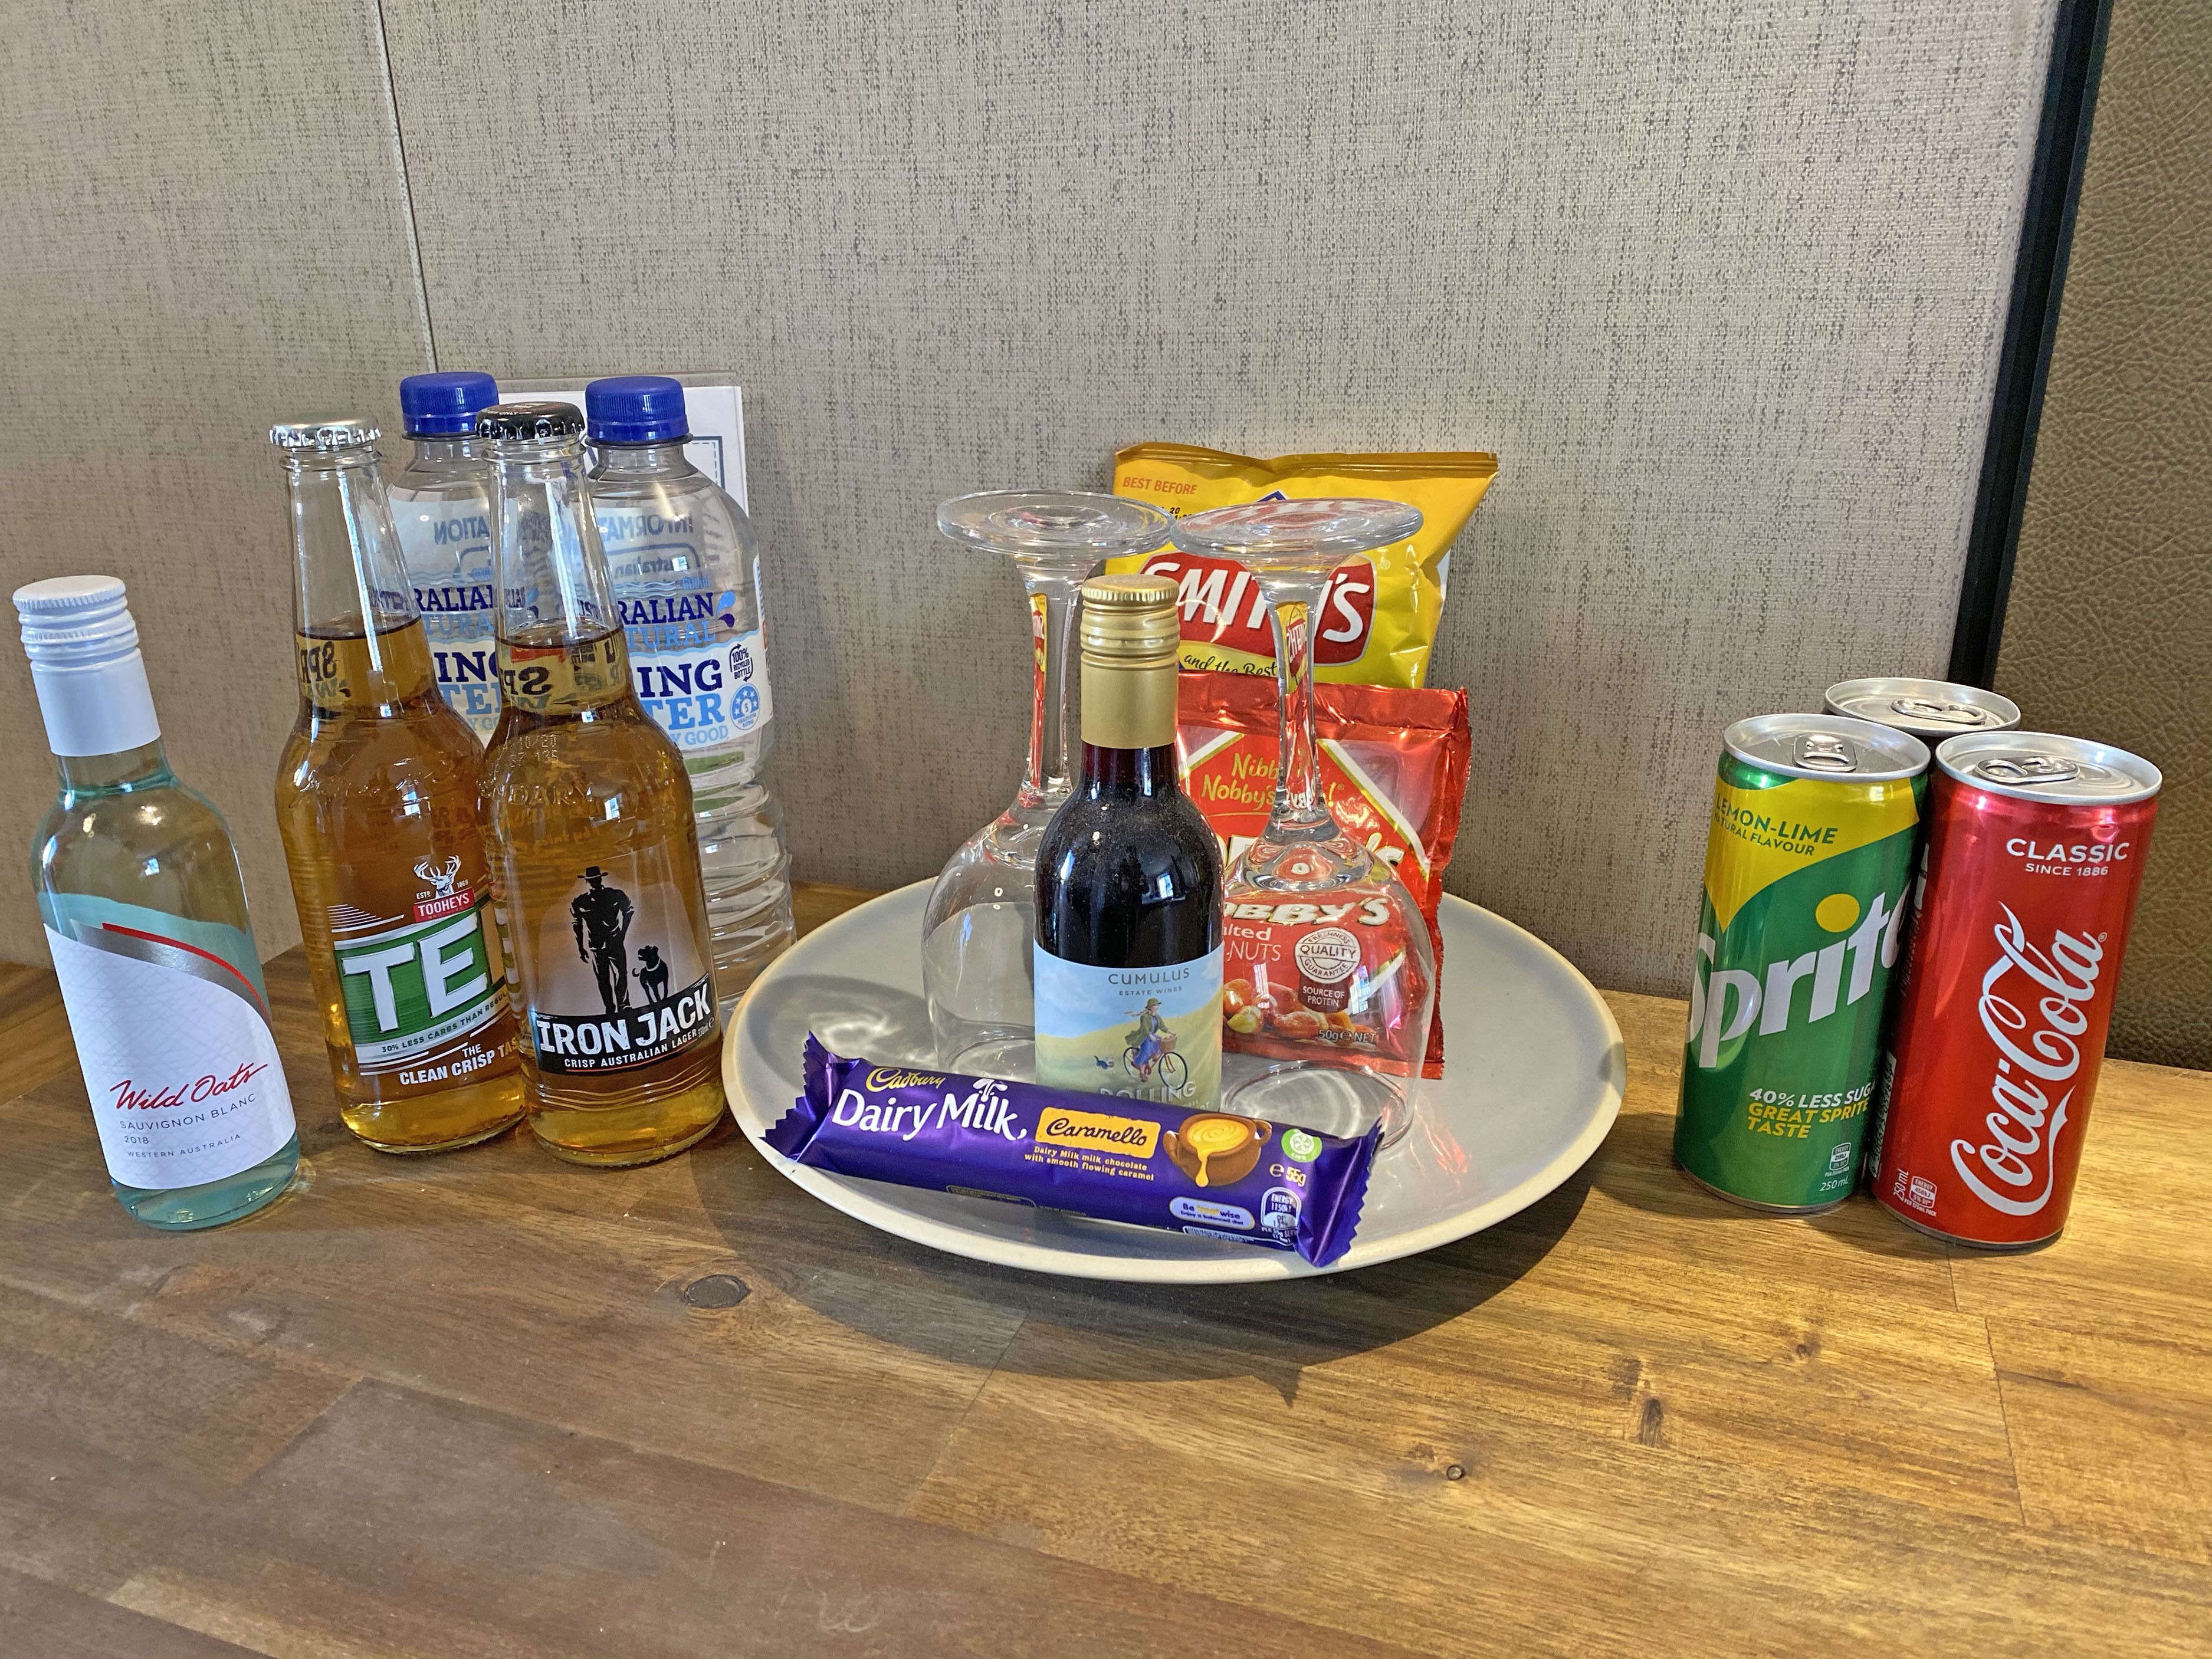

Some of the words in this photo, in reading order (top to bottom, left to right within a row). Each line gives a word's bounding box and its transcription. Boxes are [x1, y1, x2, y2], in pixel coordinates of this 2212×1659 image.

[1123, 477, 1151, 490] BEST
[1154, 480, 1198, 495] BEFORE
[618, 592, 714, 625] RALIAN
[624, 620, 717, 649] TURAL
[732, 648, 749, 663] 100%
[1184, 655, 1216, 670] and
[636, 659, 723, 698] ING
[734, 666, 751, 679] BOTTLE
[641, 693, 725, 730] TER
[685, 725, 728, 745] GOOD
[1232, 753, 1279, 780] Nibb
[1201, 774, 1276, 812] Nobby's
[1717, 794, 1838, 845] LEMON-LIME
[1714, 813, 1748, 840] NATURAL
[1750, 832, 1816, 856] FLAVOUR
[2006, 838, 2130, 863] CLASSIC
[2025, 863, 2072, 876] SINCE
[2077, 866, 2108, 876] 1886
[418, 893, 470, 916] TOOHEYS
[1308, 931, 1350, 944] FRESHNESS
[1229, 939, 1282, 962] NUTS
[1300, 944, 1356, 959] QUALITY
[1108, 968, 1190, 985] CUMULUS
[1304, 959, 1348, 977] GUARANTEE
[1156, 986, 1182, 994] WINES
[1302, 985, 1333, 997] SOURCE
[1334, 990, 1345, 998] OF
[1307, 996, 1339, 1007] PROTEIN
[382, 1042, 399, 1053] 30%
[402, 1036, 424, 1048] LESS
[428, 1023, 457, 1040] CARBS
[460, 1008, 483, 1026] THAN
[485, 993, 507, 1012] REGUL
[536, 1019, 631, 1055] IRON
[635, 983, 711, 1046] JACK
[565, 1059, 595, 1068] CRISP
[600, 1043, 668, 1067] AUSTRALIAN
[671, 1028, 697, 1049] LAGER
[1354, 1032, 1377, 1042] NET
[399, 1066, 448, 1085] CLEAN
[451, 1049, 495, 1076] CRISP
[497, 1036, 520, 1058] TAS
[462, 1043, 482, 1057] THE
[110, 1080, 189, 1110] Wild
[191, 1062, 268, 1102] Oats
[865, 1067, 946, 1093] Cadbury
[1750, 1088, 1795, 1107] 40%
[1798, 1093, 1843, 1109] LESS
[120, 1113, 205, 1130] SAUVIGNON
[211, 1093, 256, 1119] BLANC
[832, 1088, 938, 1141] Dairy
[936, 1091, 1024, 1141] Milk
[1748, 1102, 1819, 1123] GREAT
[1819, 1097, 1870, 1123] SPRITE
[1046, 1117, 1147, 1146] Caramello
[1748, 1116, 1812, 1138] TASTE
[124, 1135, 149, 1144] 2018
[180, 1134, 241, 1155] AUSTRALIA
[1024, 1154, 1043, 1163] with
[1046, 1157, 1078, 1169] smooth
[1082, 1162, 1115, 1177] flowing
[1118, 1169, 1154, 1181] caramel
[1034, 1145, 1058, 1157] Dairy
[1060, 1150, 1079, 1160] Milk
[1082, 1154, 1101, 1164] milk
[1105, 1158, 1148, 1171] chocolate
[1285, 1167, 1307, 1187] 55g
[1182, 1203, 1194, 1212] Be
[1271, 1193, 1293, 1205] ENERGY
[1180, 1210, 1196, 1218] Enjoy
